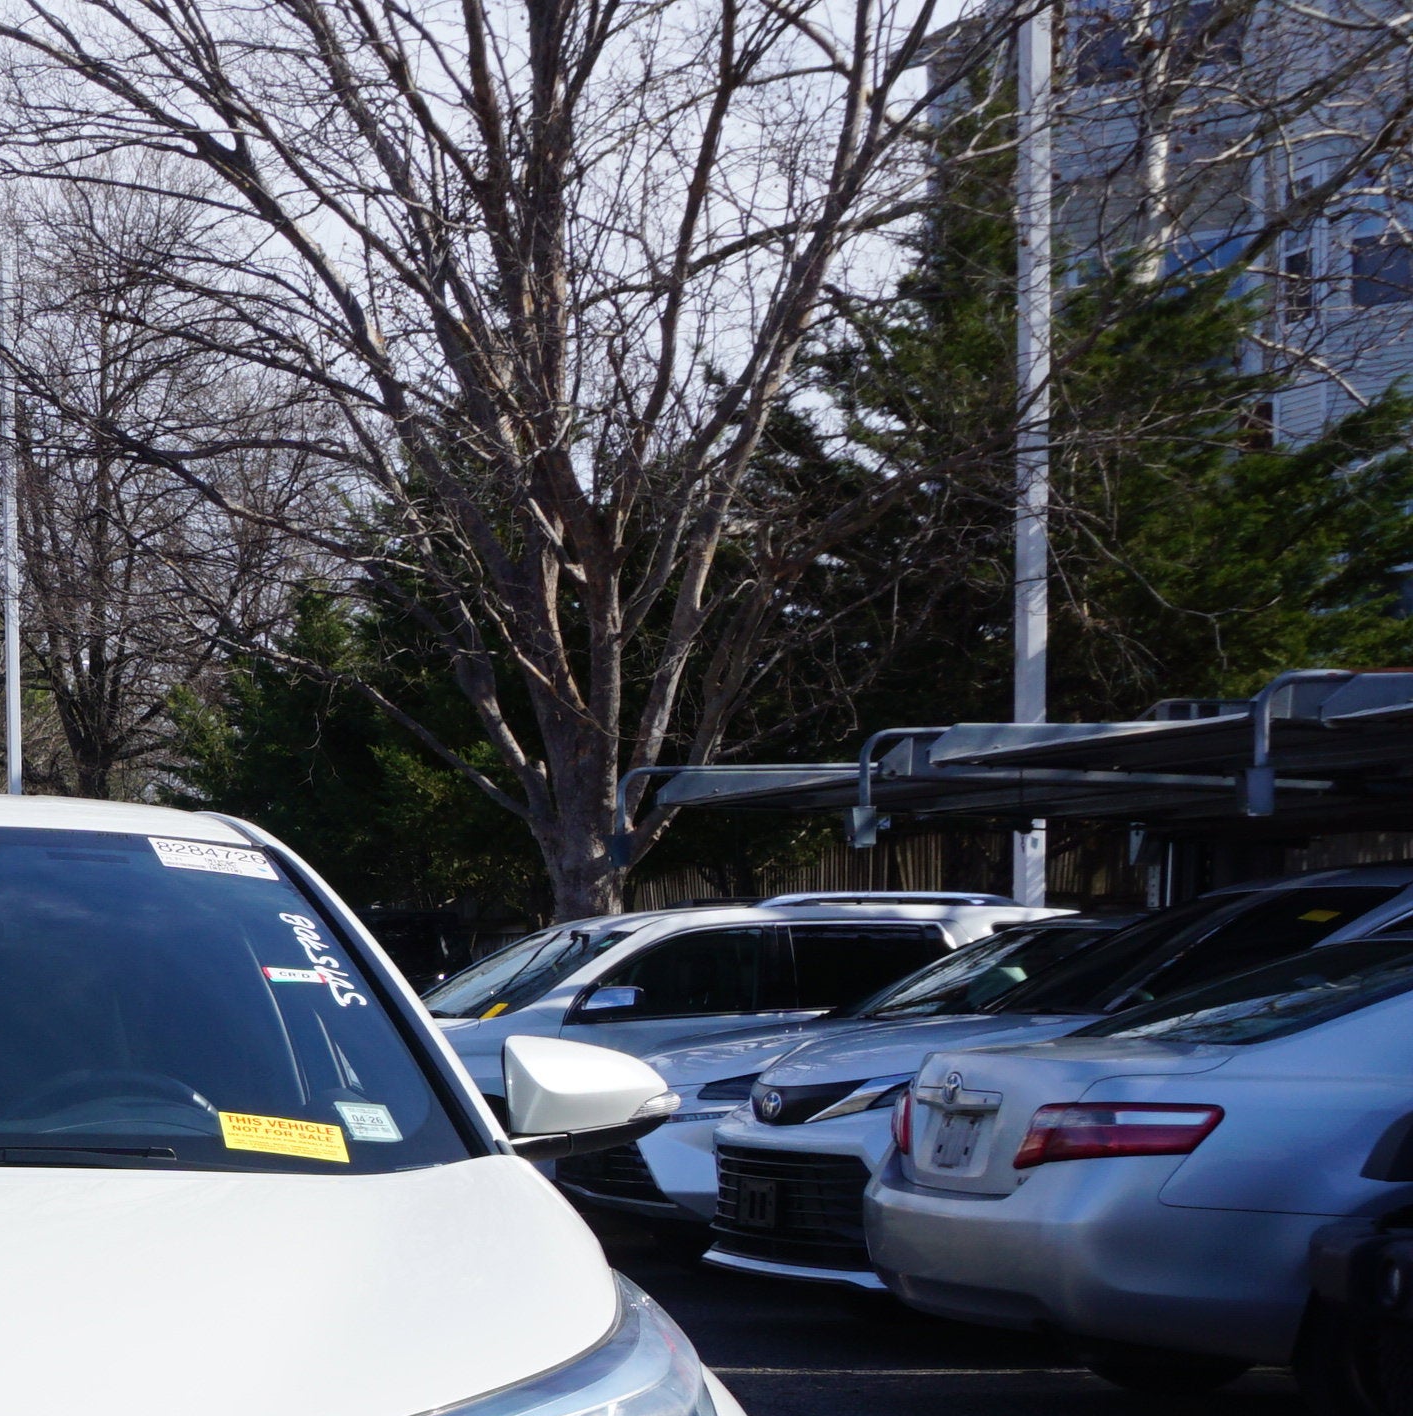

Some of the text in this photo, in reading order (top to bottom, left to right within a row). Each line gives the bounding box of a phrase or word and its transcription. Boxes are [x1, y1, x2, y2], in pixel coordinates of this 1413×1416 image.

[156, 841, 267, 865] 8284726
[226, 1115, 335, 1136] THIS VEHICLE
[232, 1125, 333, 1143] NOT FOR SALE
